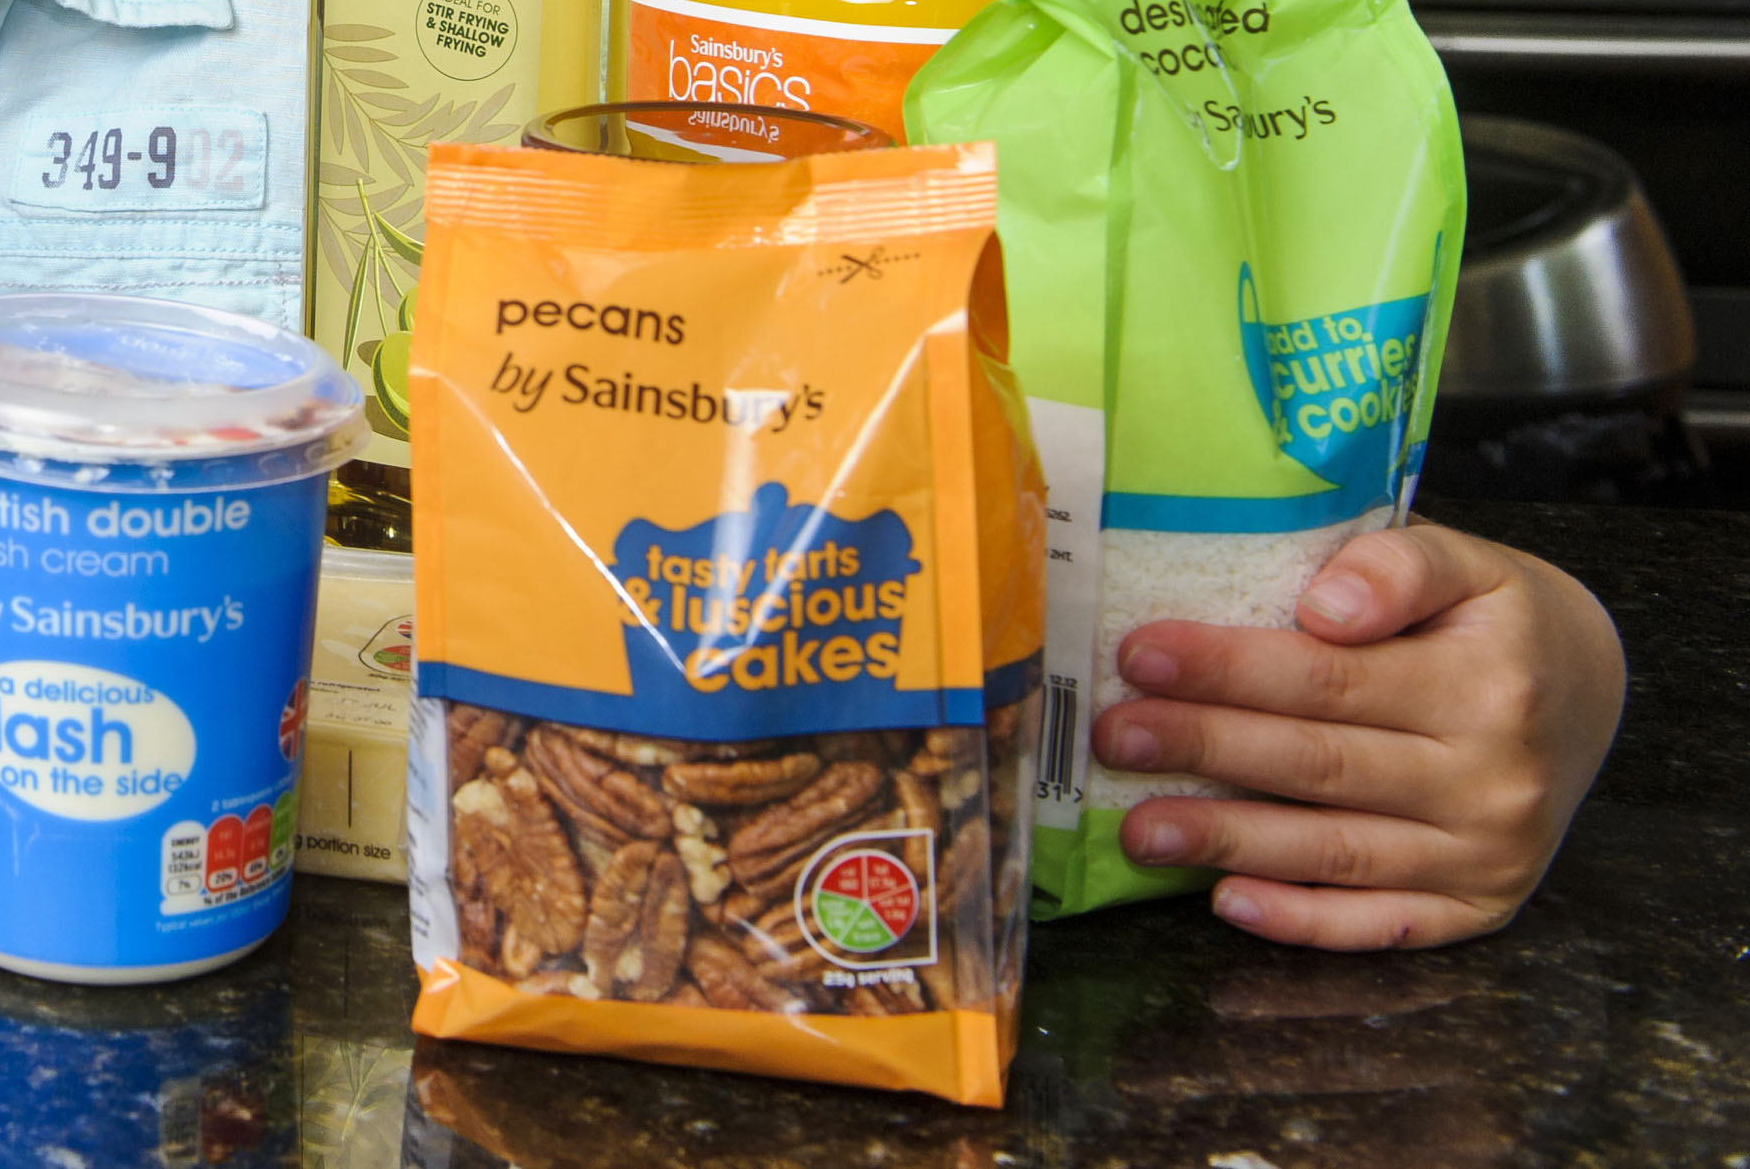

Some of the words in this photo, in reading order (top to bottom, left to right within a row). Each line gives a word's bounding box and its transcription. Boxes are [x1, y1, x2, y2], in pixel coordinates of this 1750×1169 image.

[427, 2, 454, 19] STIR
[458, 11, 509, 35] FRYING
[477, 1, 500, 16] FOR
[426, 17, 436, 29] &
[439, 20, 504, 48] SHALLOW
[436, 35, 486, 57] FRYING
[690, 34, 783, 69] Sainsbury's
[669, 39, 810, 112] basics
[496, 299, 684, 345] pecans
[1323, 316, 1362, 344] to
[491, 352, 553, 413] by
[561, 364, 825, 433] Sainsbury's
[87, 497, 250, 538] double
[41, 547, 169, 576] cream
[646, 545, 755, 594] tasty
[765, 541, 860, 582] tarts
[11, 595, 244, 643] Sainsbury's
[620, 576, 662, 627] &
[671, 581, 905, 636] luscious
[684, 630, 900, 693] cakes
[25, 678, 155, 704] delicious
[1, 766, 38, 790] on
[50, 767, 103, 795] the
[116, 769, 184, 796] side
[172, 836, 199, 846] ENERGY
[307, 836, 360, 856] portion
[364, 843, 391, 860] size
[179, 881, 190, 889] 7%
[216, 895, 222, 903] of
[226, 891, 237, 901] the
